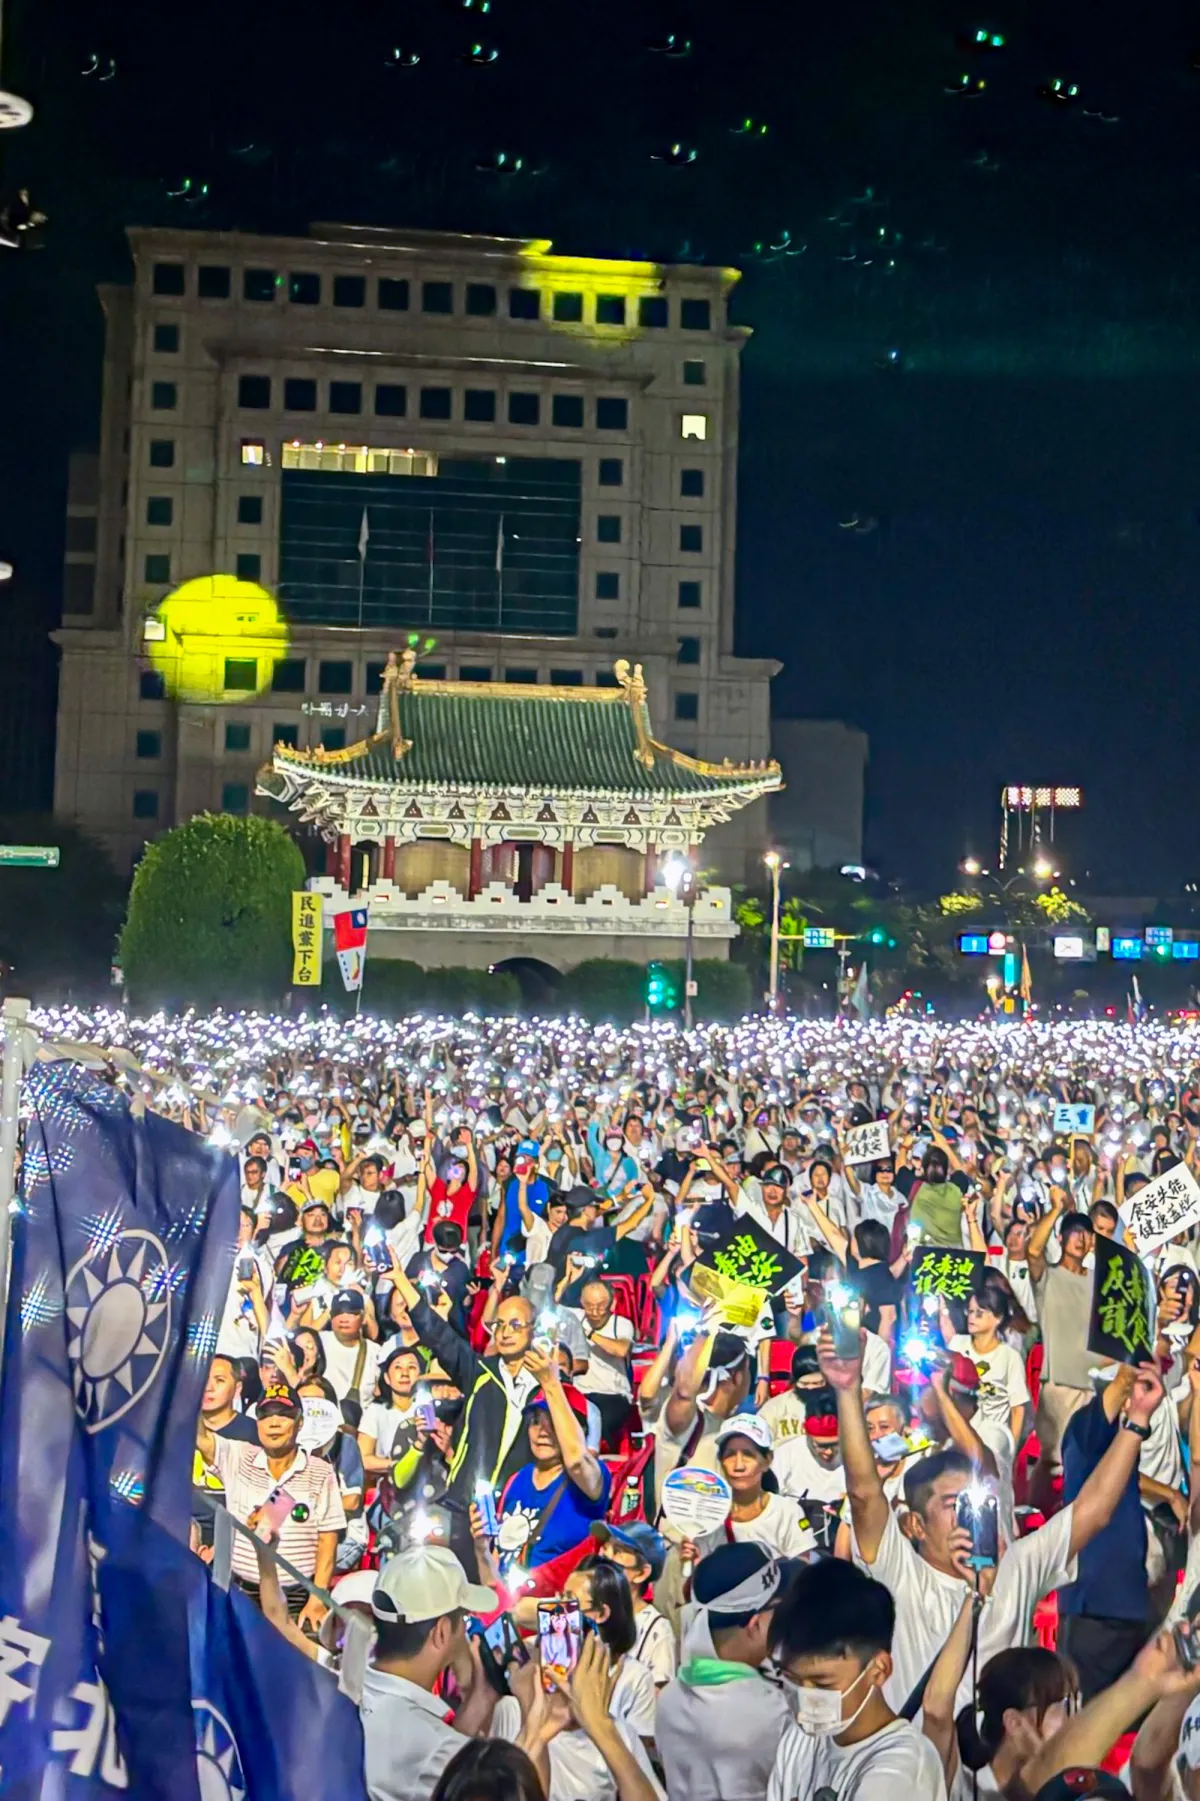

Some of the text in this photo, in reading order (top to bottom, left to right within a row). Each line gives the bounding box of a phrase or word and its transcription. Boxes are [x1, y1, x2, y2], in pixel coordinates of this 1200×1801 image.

[297, 896, 317, 983] 民進黨下台
[1131, 1178, 1187, 1222] 食安失能
